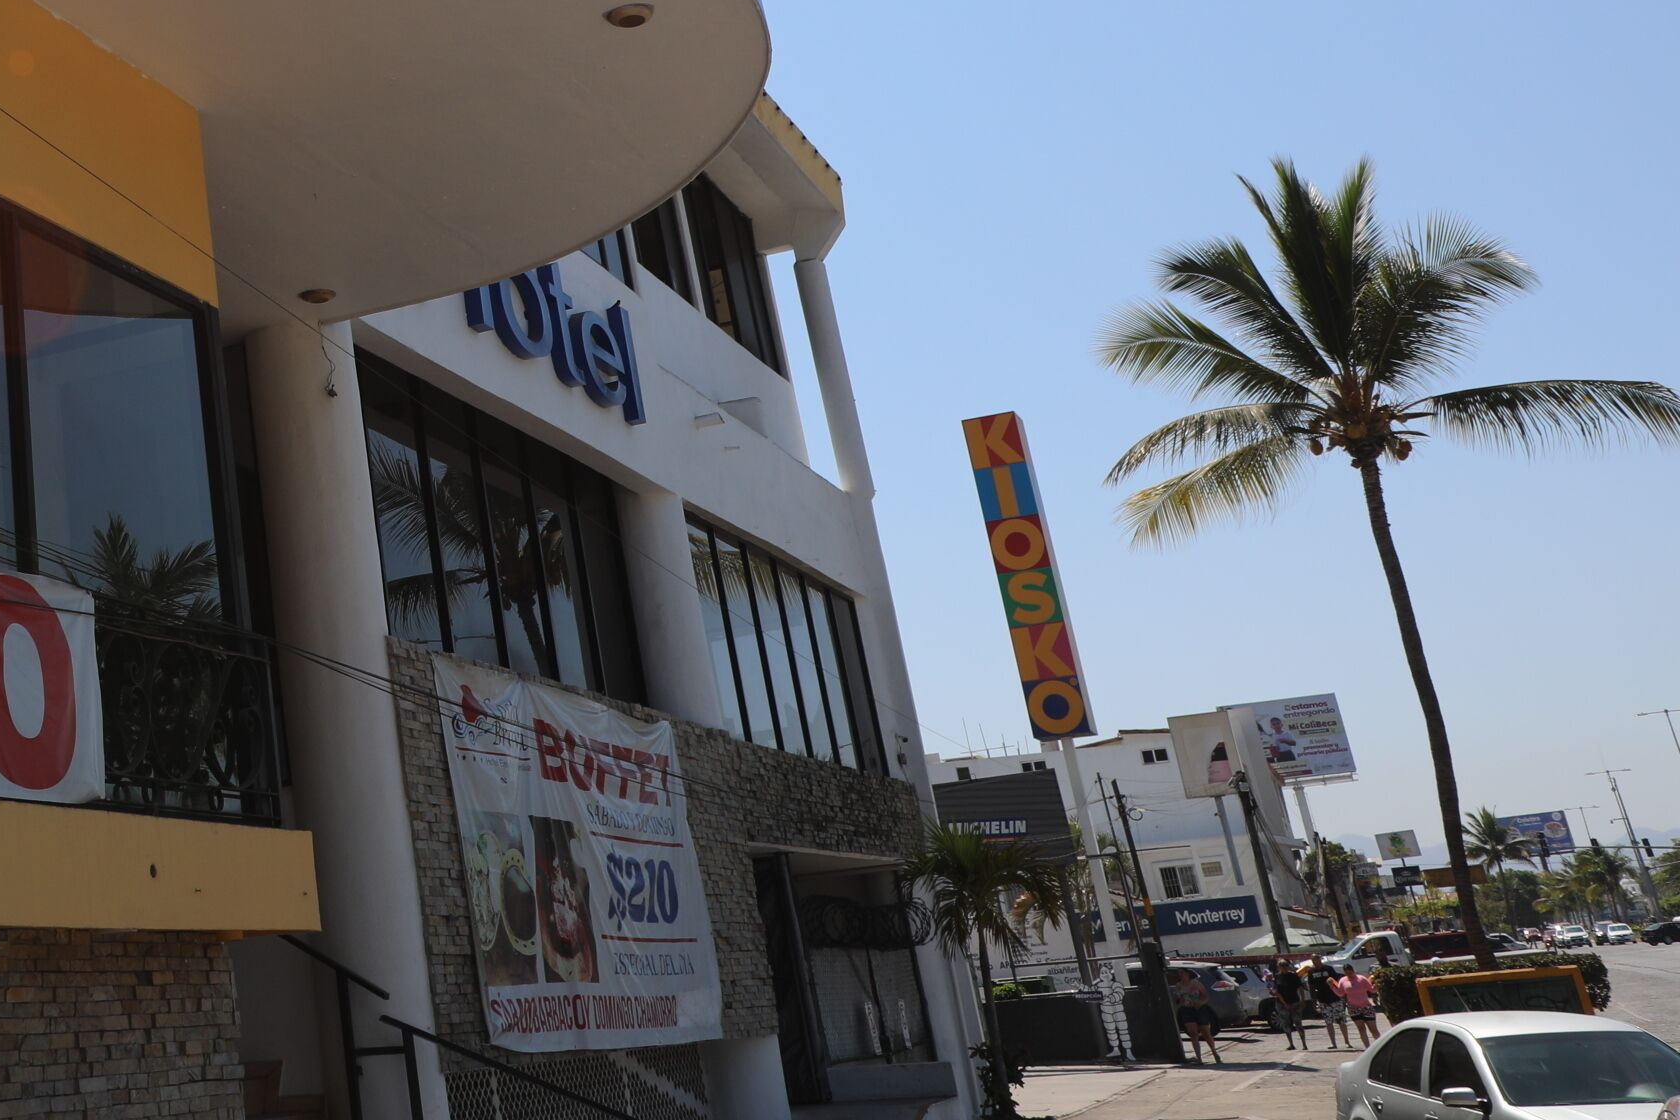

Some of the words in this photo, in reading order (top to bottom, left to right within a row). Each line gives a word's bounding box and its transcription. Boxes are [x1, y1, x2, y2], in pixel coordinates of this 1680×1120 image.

[961, 411, 1085, 736] KIOSKO
[532, 717, 672, 808] BUFFET
[606, 845, 680, 931] $210
[1175, 908, 1246, 927] Monterrey
